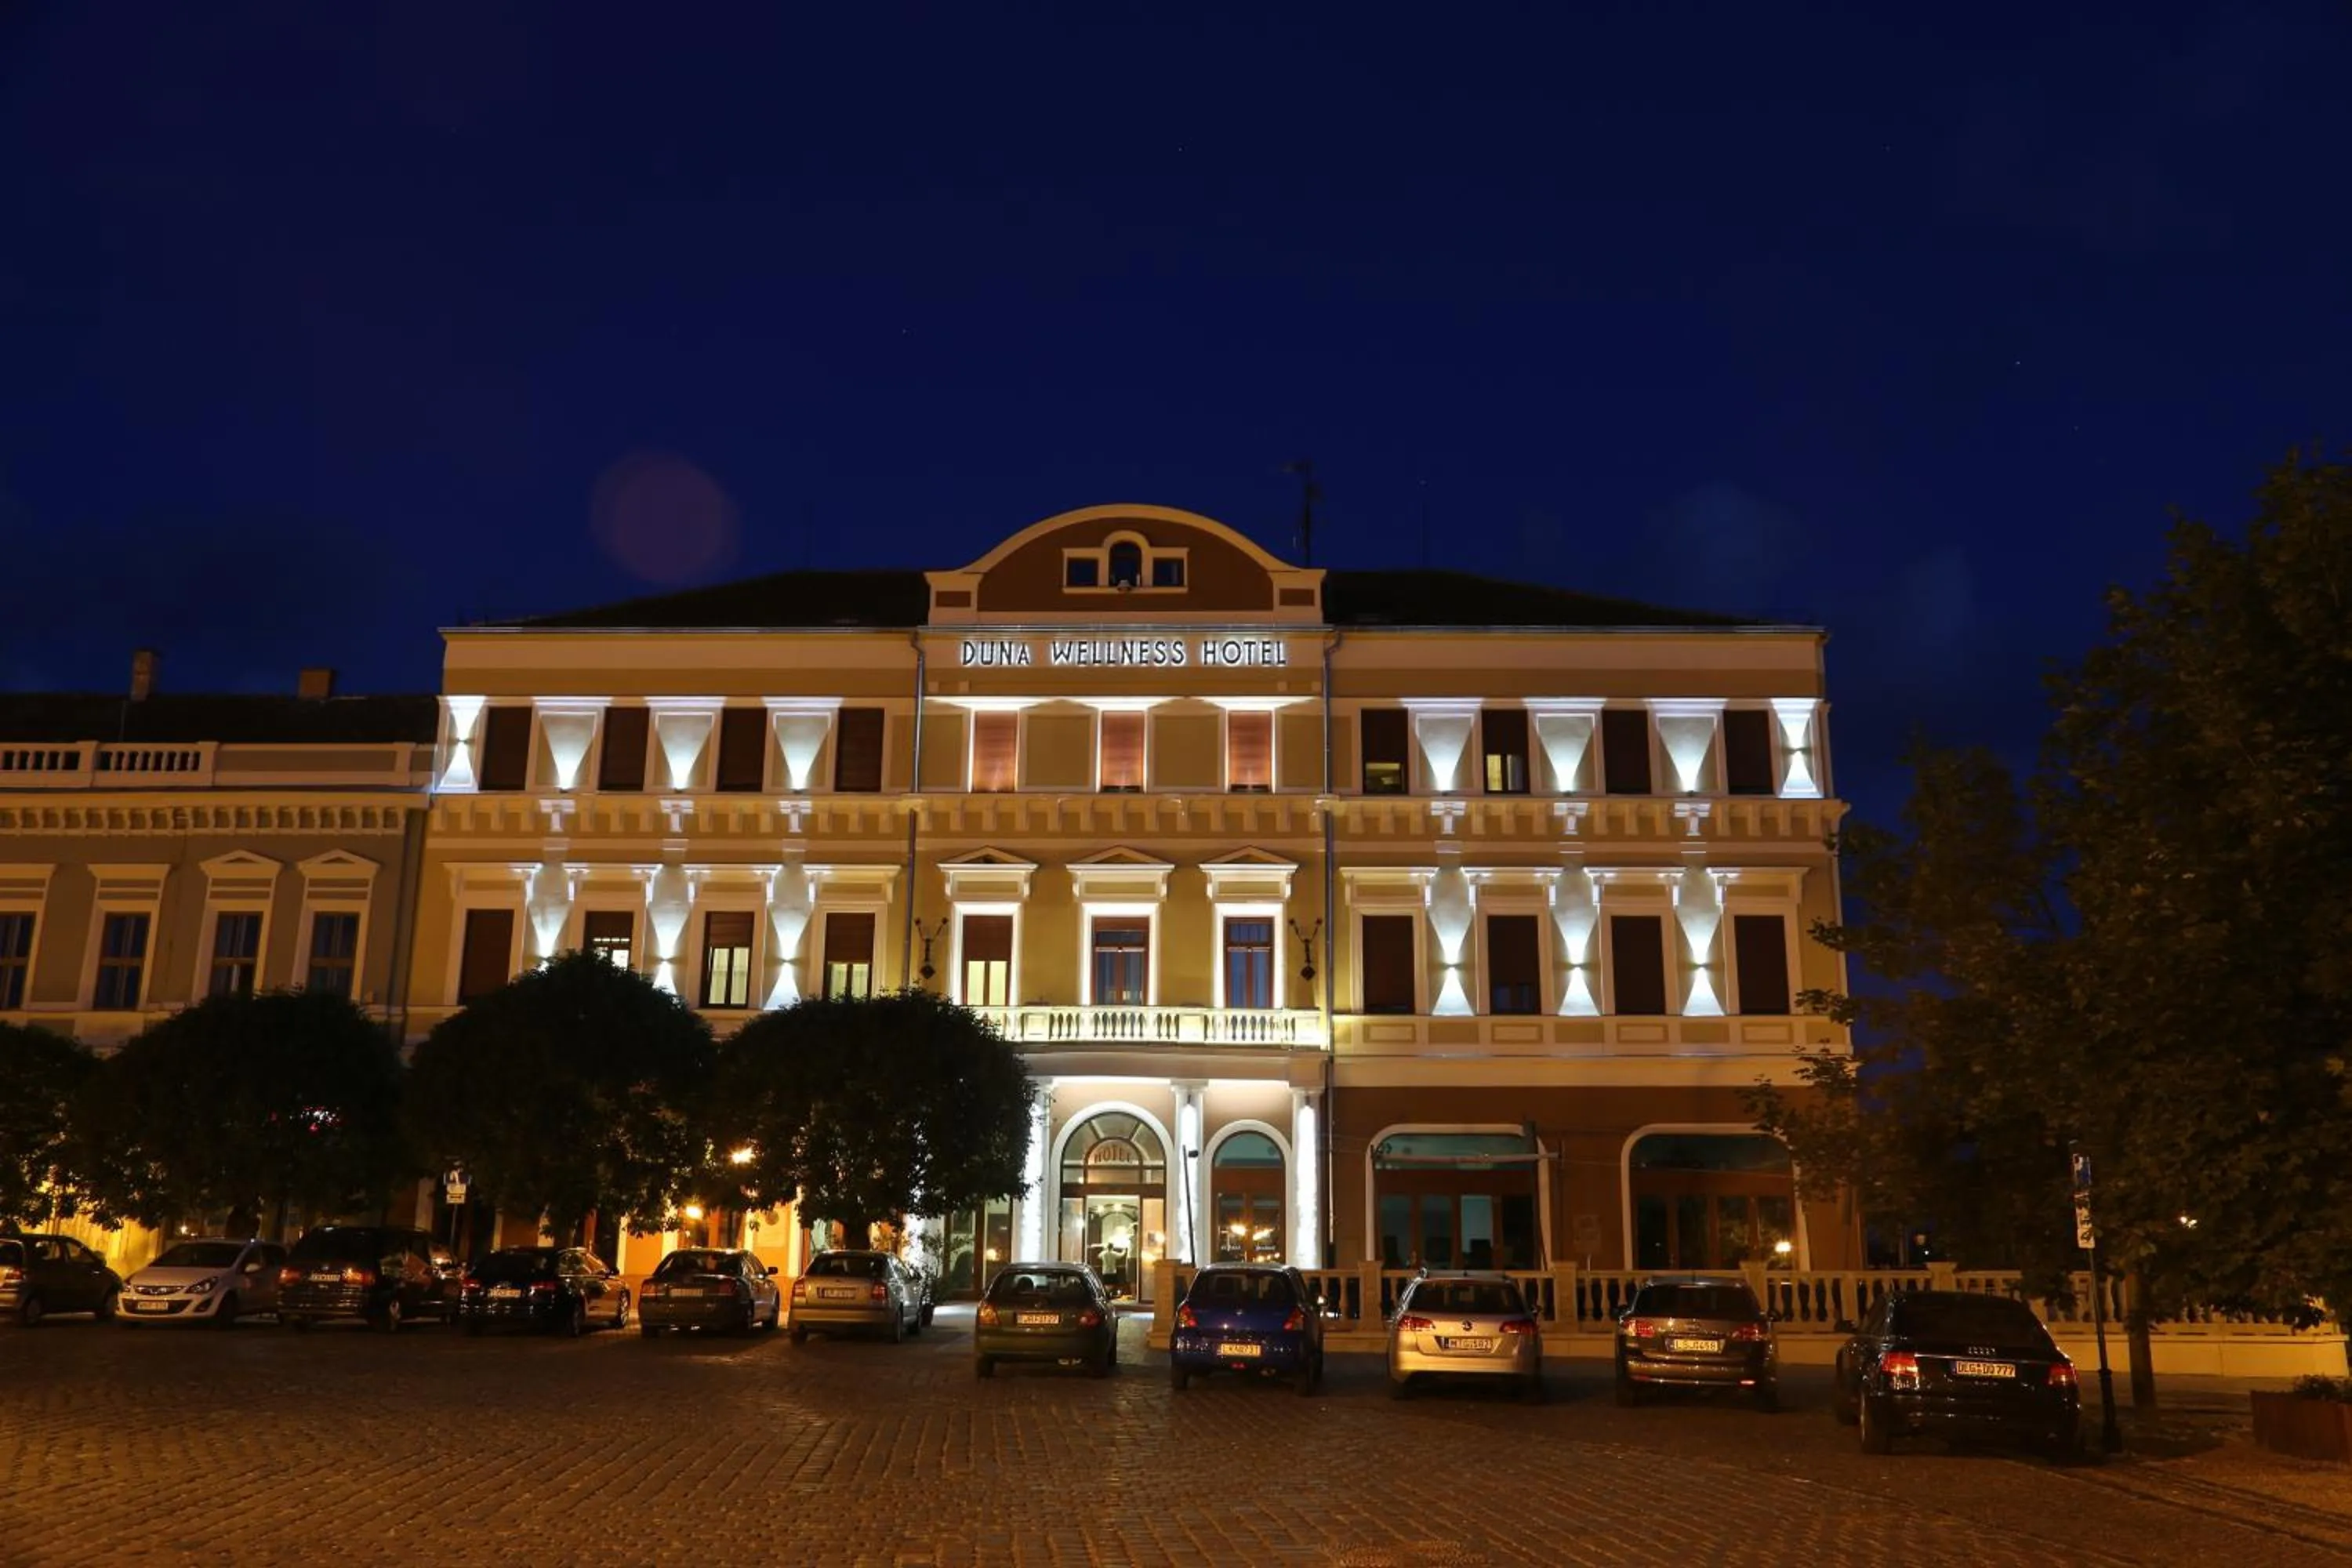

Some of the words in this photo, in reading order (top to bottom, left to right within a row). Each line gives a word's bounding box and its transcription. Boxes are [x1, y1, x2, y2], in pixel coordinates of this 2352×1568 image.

[962, 641, 1030, 666] DUNA
[1052, 640, 1185, 665] WELLNESS
[1203, 640, 1287, 666] HOTEL
